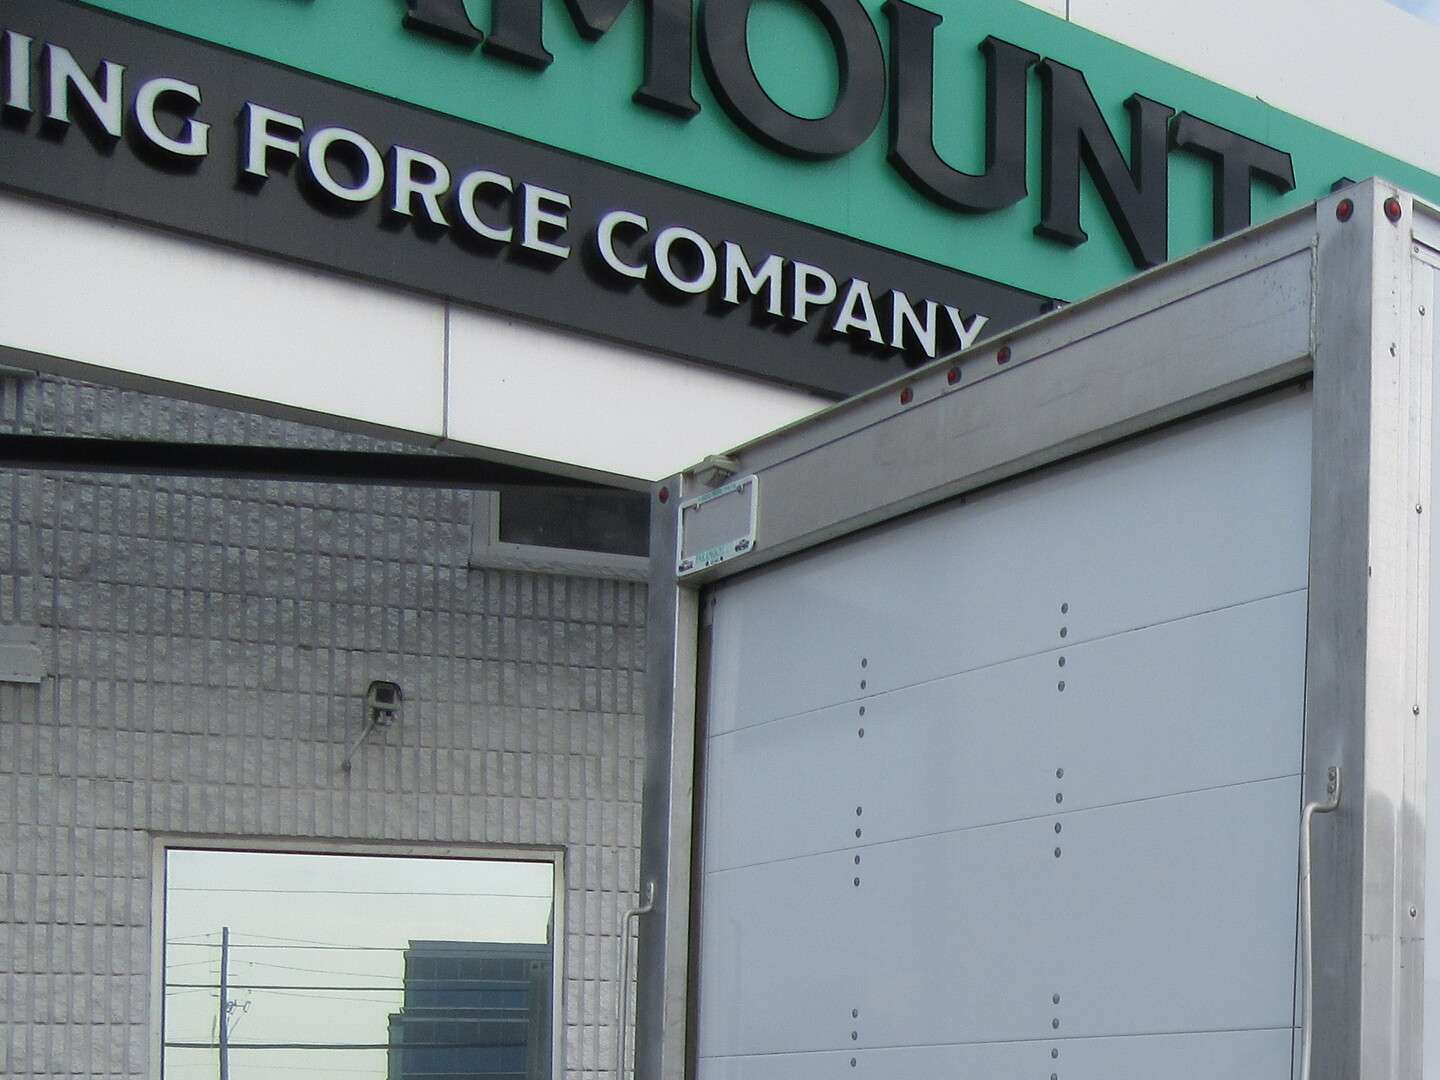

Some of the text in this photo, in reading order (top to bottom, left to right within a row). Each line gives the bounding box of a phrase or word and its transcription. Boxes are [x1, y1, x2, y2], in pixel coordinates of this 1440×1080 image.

[4, 29, 990, 358] ING FORCE COMPANY
[400, 0, 1297, 270] MOUNT
